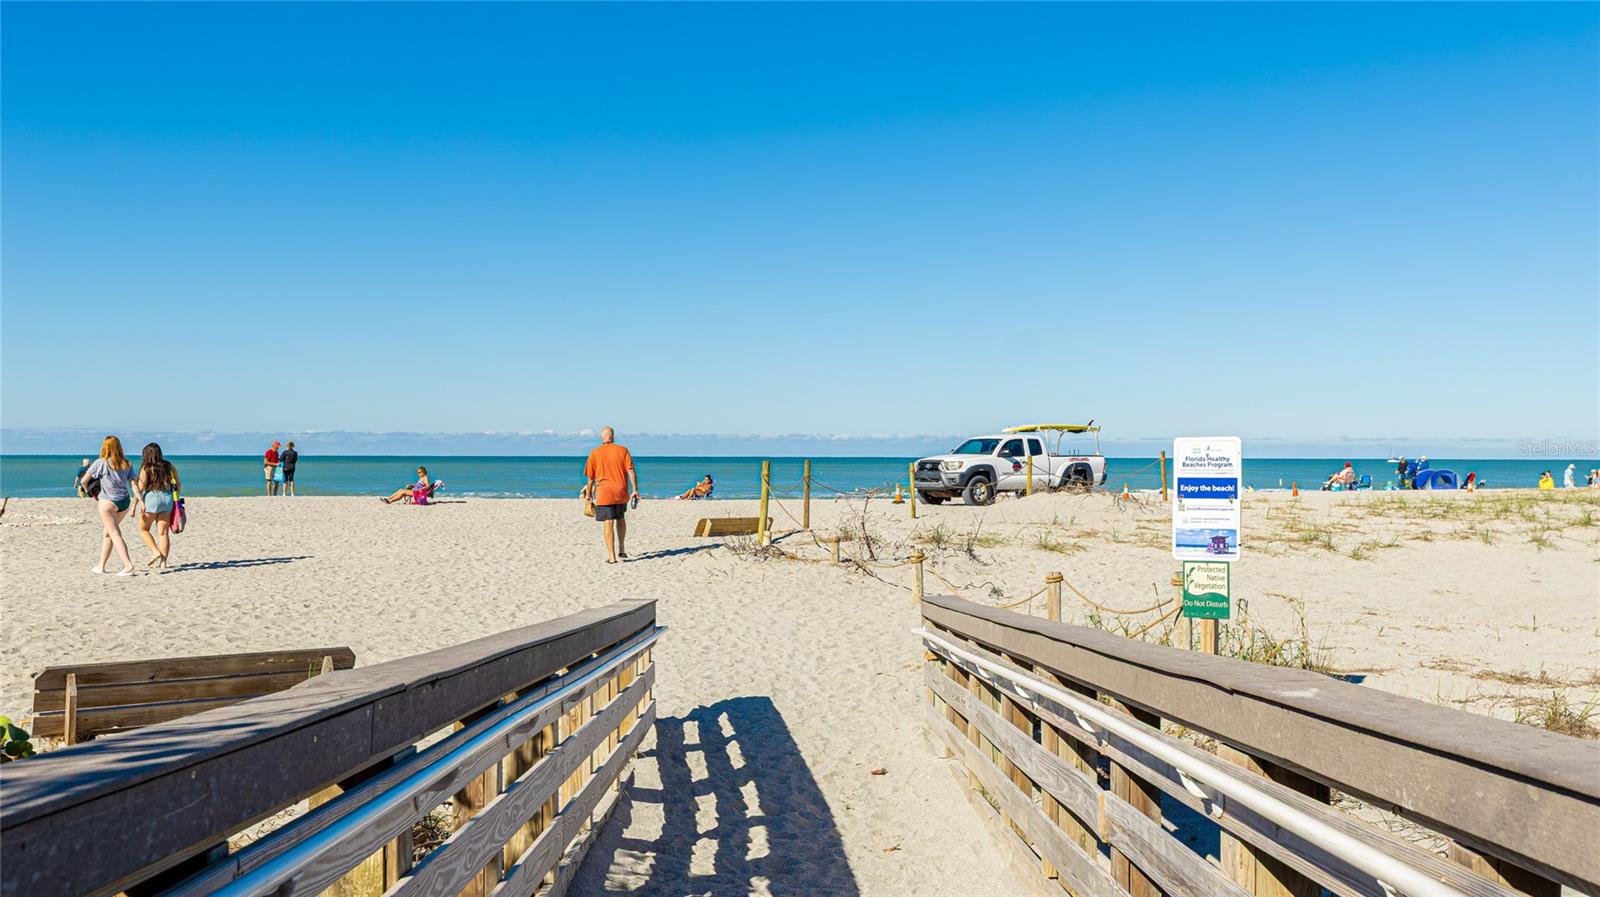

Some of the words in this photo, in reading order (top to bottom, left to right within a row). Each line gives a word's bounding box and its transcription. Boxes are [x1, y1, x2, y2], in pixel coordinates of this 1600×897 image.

[1180, 484, 1198, 492] Enjoy
[1194, 582, 1226, 590] Vegetation
[1206, 600, 1229, 608] Disturb
